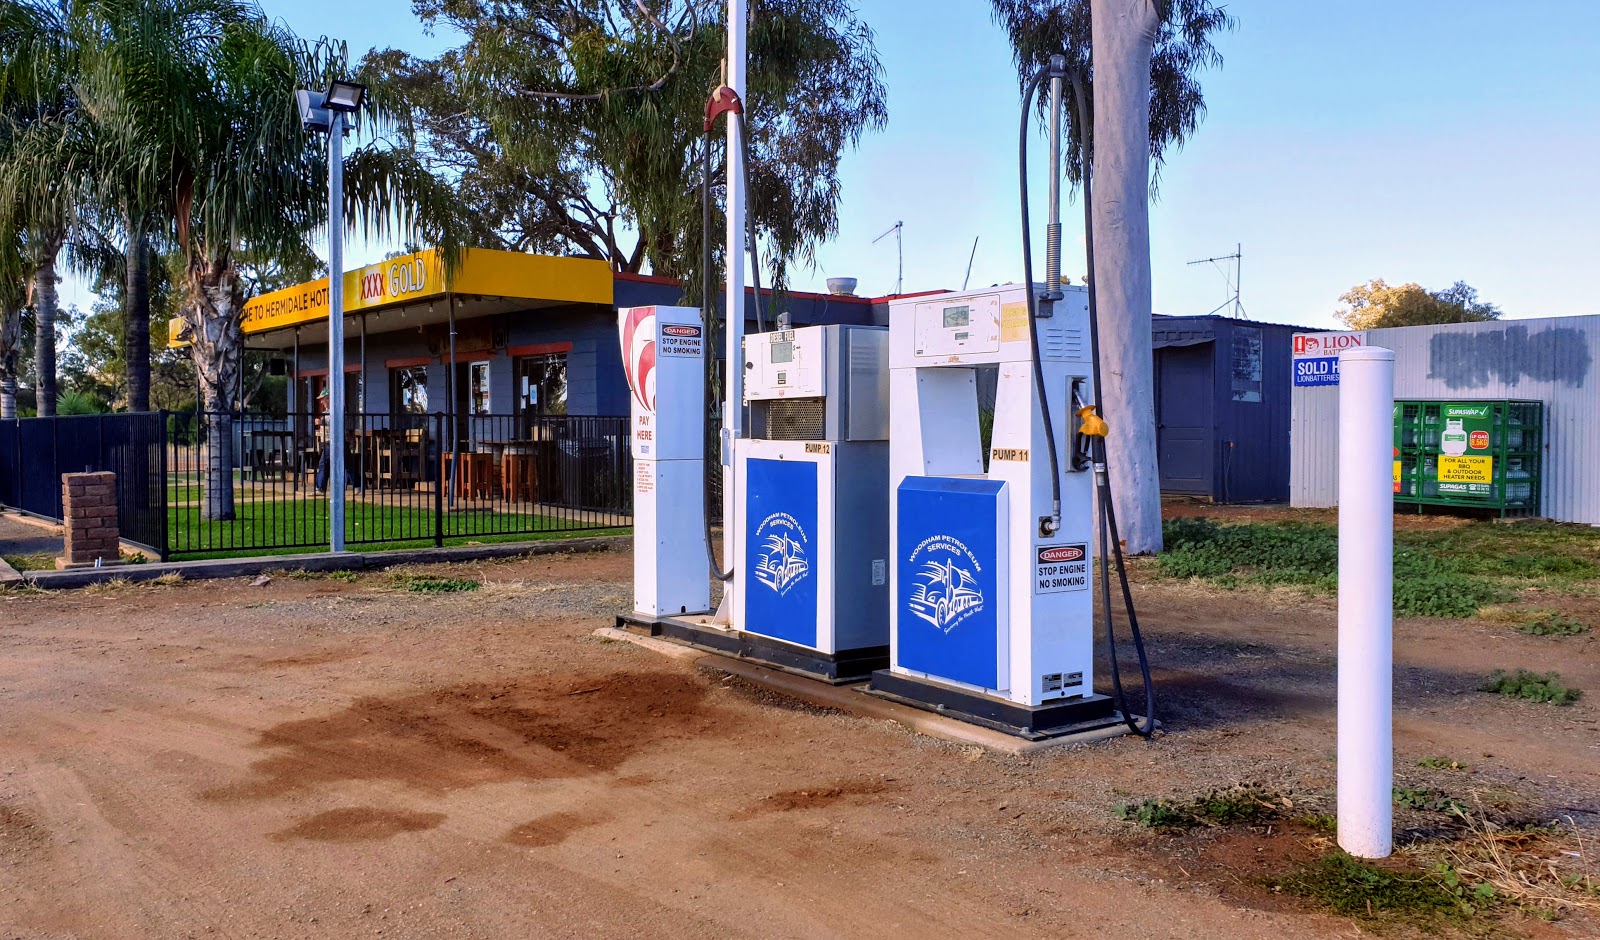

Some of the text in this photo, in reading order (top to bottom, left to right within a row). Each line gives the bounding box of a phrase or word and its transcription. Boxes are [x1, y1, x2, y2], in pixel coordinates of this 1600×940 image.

[361, 257, 426, 301] XXXX GOLD
[254, 304, 264, 321] TO
[265, 293, 308, 318] HERMIDALE
[310, 287, 329, 308] HOT
[770, 330, 795, 343] DIESEL FUEL
[1323, 335, 1361, 349] LION
[673, 347, 701, 355] SMOKING
[1297, 361, 1328, 375] SOLD
[1297, 374, 1339, 383] LIONBATTERIES
[639, 415, 650, 426] PAY
[636, 429, 652, 441] HERE
[805, 443, 830, 454] PUMP 12
[992, 449, 1028, 461] PUMP 11
[756, 512, 808, 543] WOODHAM PETROLEUM
[769, 519, 794, 531] SERVICES
[909, 535, 982, 572] WOODHAM PETROLEUM
[927, 543, 961, 556] SERVICES
[1044, 550, 1079, 559] DANGER
[1038, 564, 1086, 576] STOP ENGINE
[1039, 576, 1085, 589] NO SMOKING
